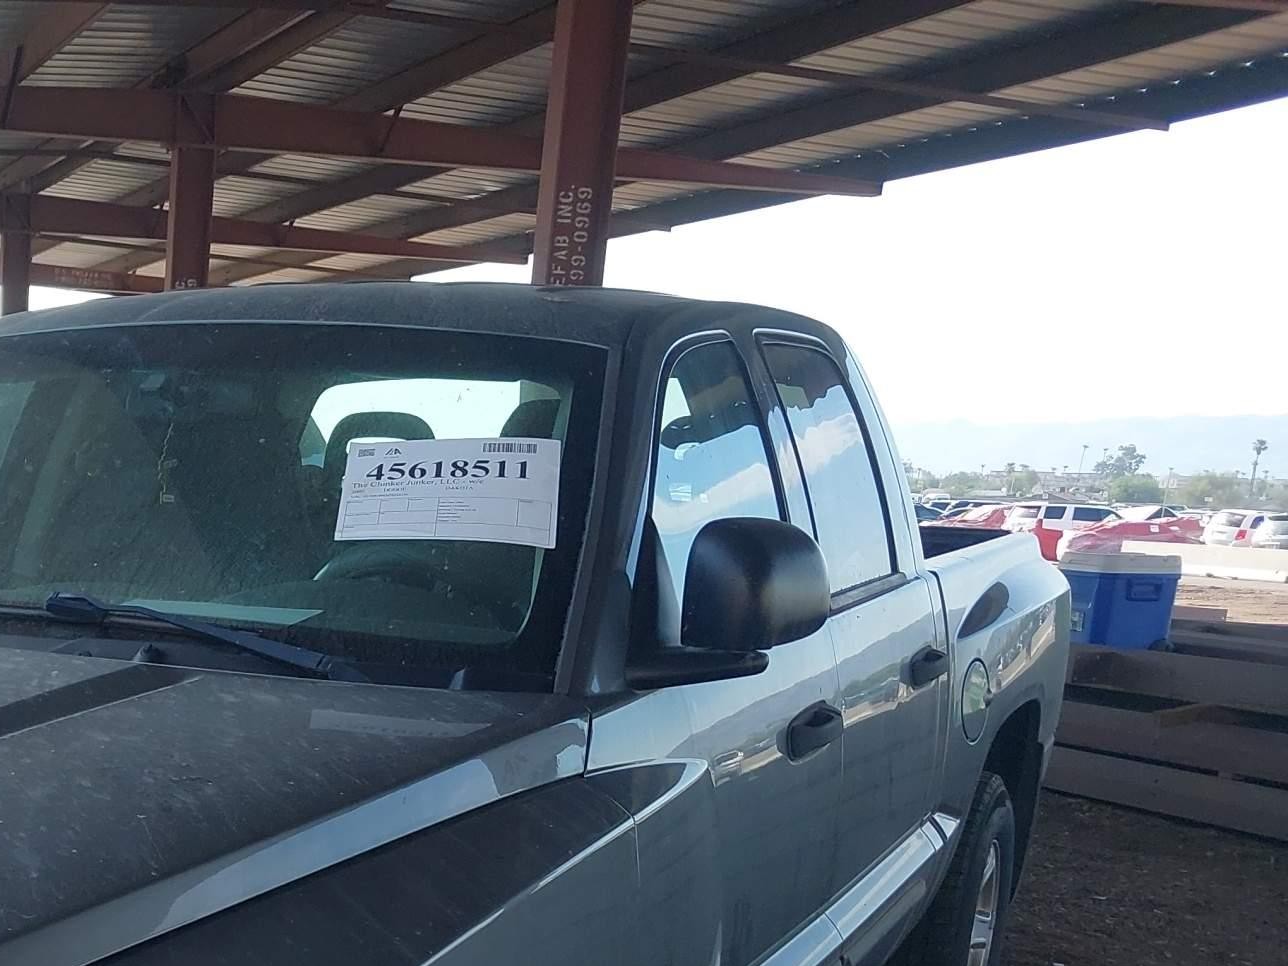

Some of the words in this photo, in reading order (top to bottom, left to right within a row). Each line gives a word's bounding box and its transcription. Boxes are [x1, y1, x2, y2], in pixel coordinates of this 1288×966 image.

[556, 185, 575, 223] INC.
[569, 187, 593, 287] 99-0969
[366, 460, 529, 481] 45618511
